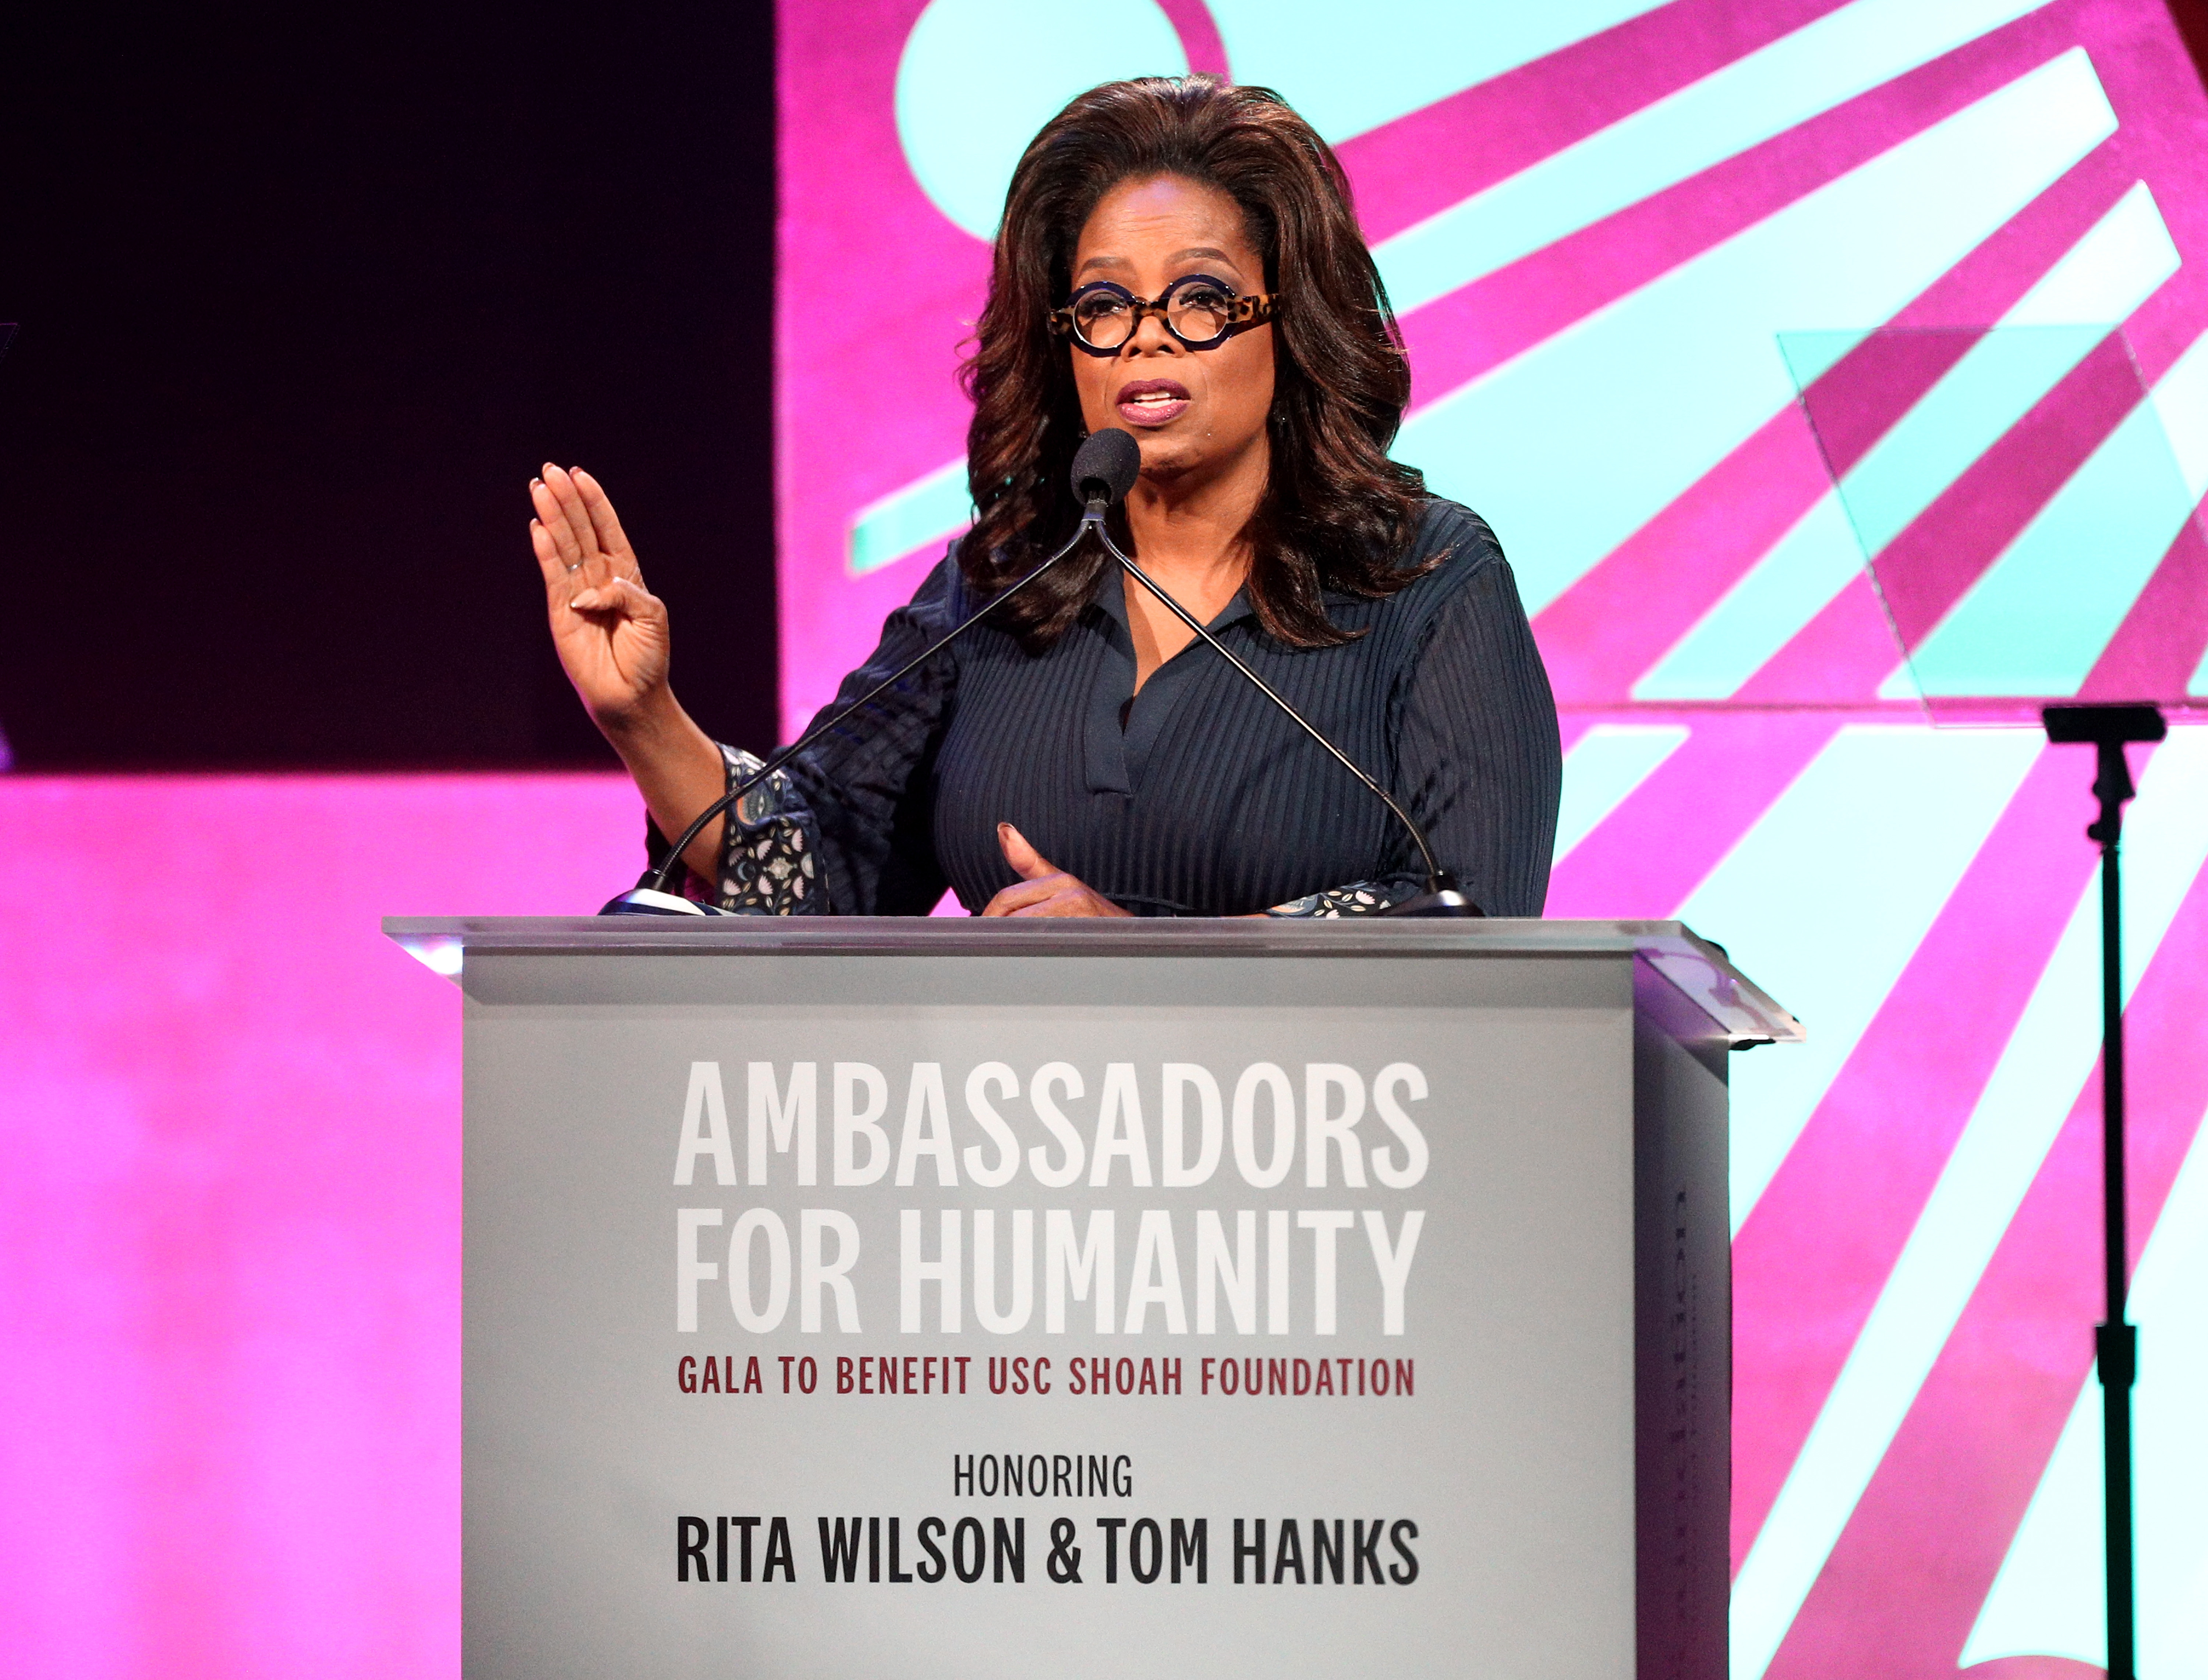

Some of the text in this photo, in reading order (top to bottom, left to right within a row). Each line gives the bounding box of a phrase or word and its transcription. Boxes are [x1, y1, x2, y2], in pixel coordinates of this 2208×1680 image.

[674, 1061, 1429, 1188] AMBASSADORS
[678, 1208, 1425, 1335] FOR HUMANITY
[678, 1356, 1414, 1396] GALA TO BENEFIT USC SHOAH FOUNDATION
[955, 1454, 1132, 1497] HONORING
[678, 1516, 1419, 1585] RITA WILSON & TOM HANKS
